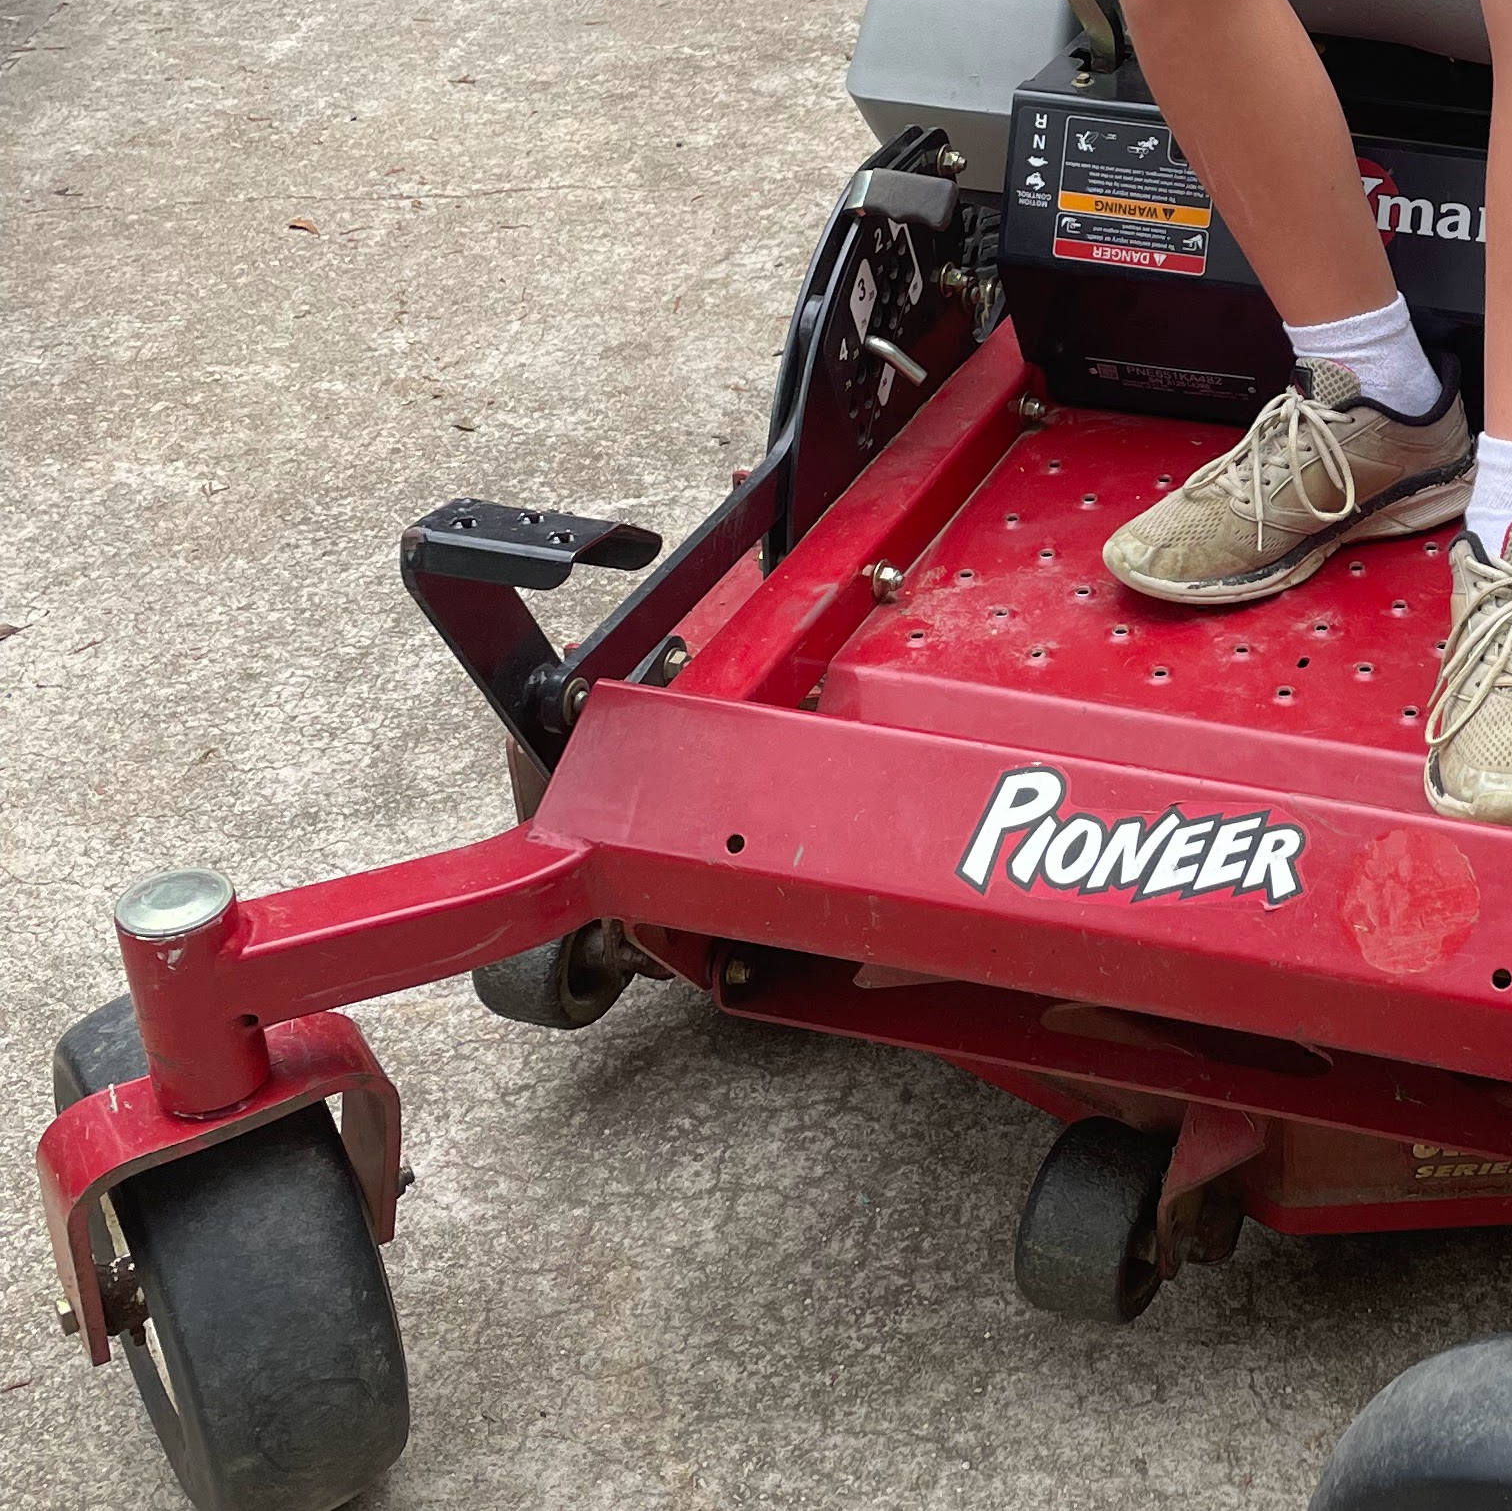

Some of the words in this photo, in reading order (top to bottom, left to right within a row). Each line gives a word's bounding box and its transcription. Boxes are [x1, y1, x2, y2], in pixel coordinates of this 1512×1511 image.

[1034, 113, 1048, 129] R
[1032, 133, 1046, 149] N
[1016, 190, 1052, 201] CONTROL
[1018, 198, 1048, 208] MOTION
[1094, 200, 1158, 218] WARNING
[1361, 177, 1487, 242] mar
[874, 228, 883, 253] 2
[1092, 246, 1150, 264] DANGER
[858, 279, 866, 301] 3
[839, 338, 848, 361] 4
[958, 769, 1303, 902] PIONEER
